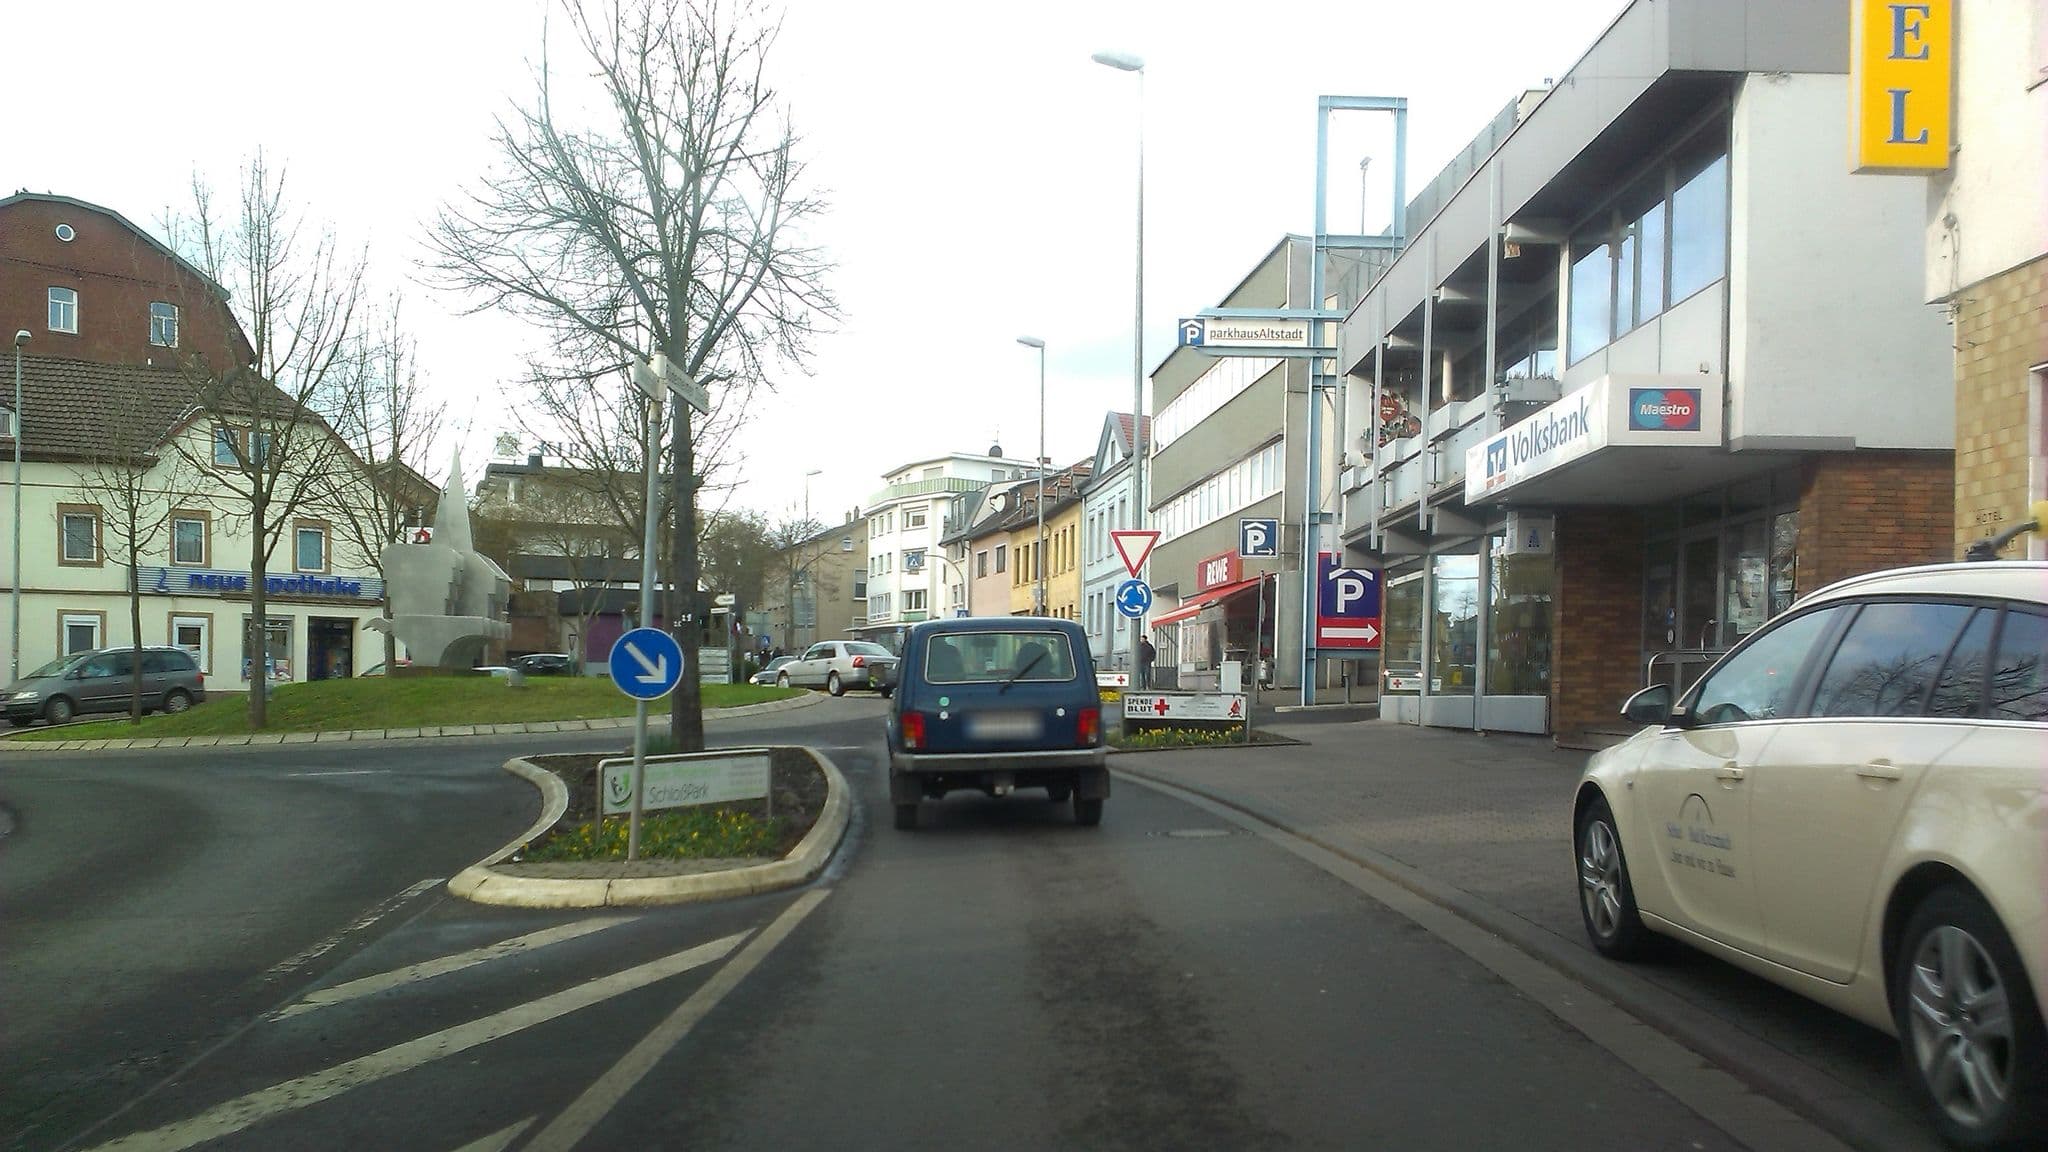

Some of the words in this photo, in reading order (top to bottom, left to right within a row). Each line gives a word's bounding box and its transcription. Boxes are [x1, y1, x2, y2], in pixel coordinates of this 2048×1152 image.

[1210, 327, 1304, 340] parkhausAltstadt
[1640, 402, 1691, 416] Maestro
[1511, 396, 1589, 466] Volksbank
[1976, 510, 2004, 523] HOTEL
[1246, 529, 1266, 554] P
[1206, 557, 1229, 587] REWE
[1337, 578, 1365, 613] P
[1127, 705, 1153, 713] BLUT
